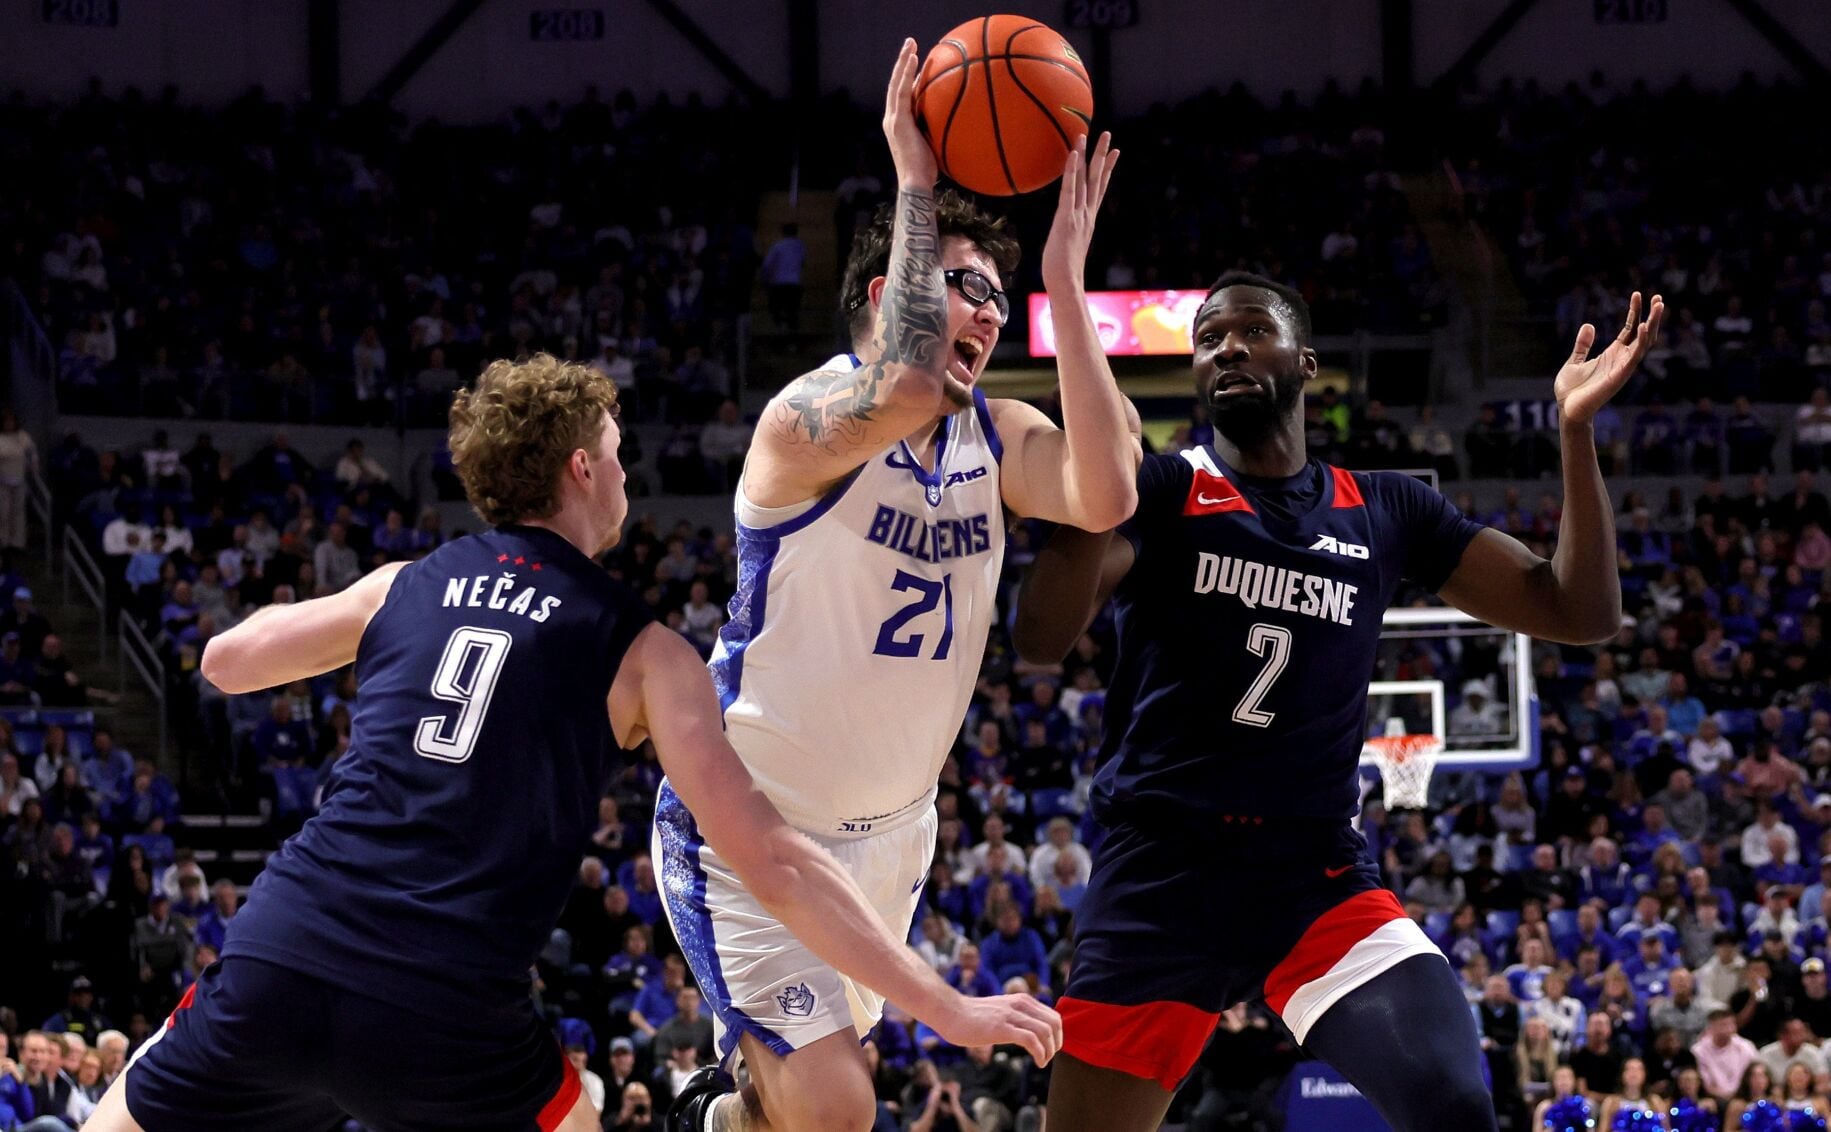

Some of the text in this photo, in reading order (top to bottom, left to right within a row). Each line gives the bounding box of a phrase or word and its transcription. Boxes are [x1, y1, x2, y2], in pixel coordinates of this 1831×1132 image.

[944, 466, 987, 489] A10
[1308, 533, 1370, 560] A10
[442, 571, 562, 623] NEČAS
[872, 568, 953, 660] 21
[1193, 551, 1359, 626] DUQUESNE
[413, 625, 513, 764] 9
[1231, 622, 1293, 728] 2
